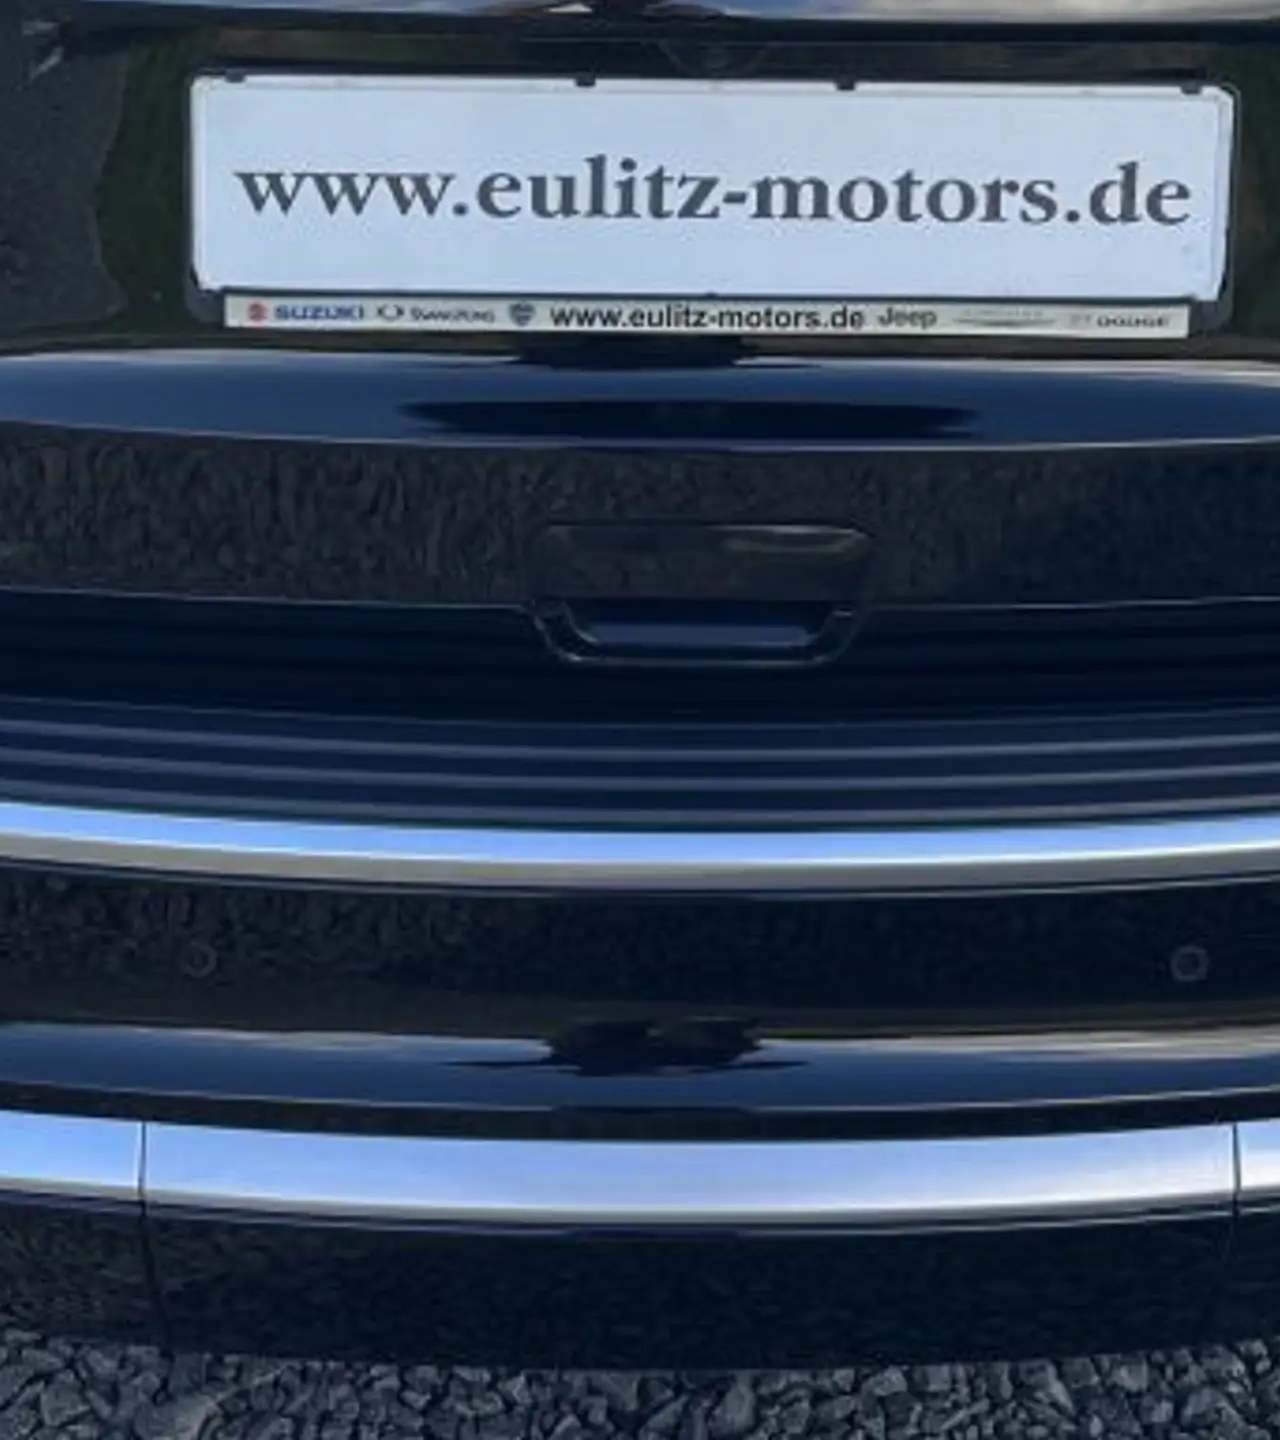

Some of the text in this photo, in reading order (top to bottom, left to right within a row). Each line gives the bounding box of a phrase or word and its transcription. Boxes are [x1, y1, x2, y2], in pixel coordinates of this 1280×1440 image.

[234, 154, 1192, 226] www.eulitz-motors.de
[274, 304, 365, 321] SUZUKI
[550, 303, 865, 330] www.eulitz-motors.de
[876, 308, 938, 331] Jeep
